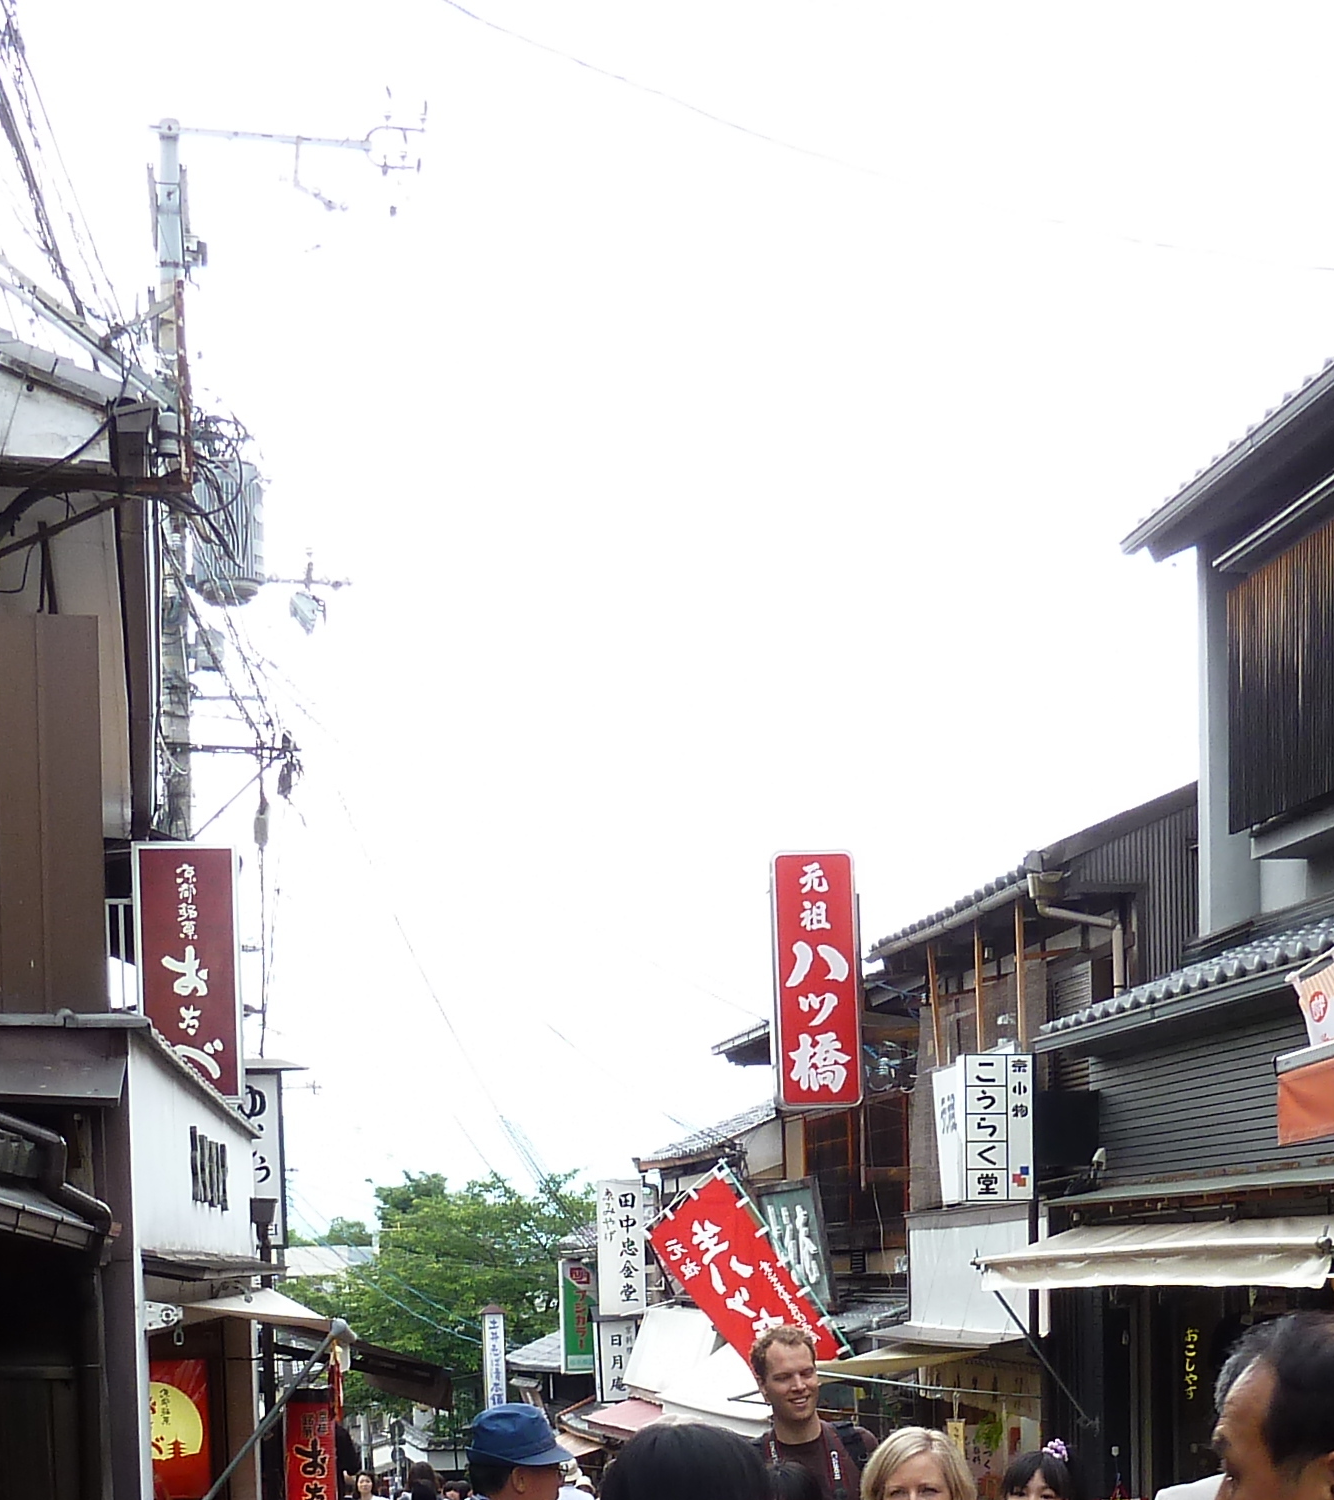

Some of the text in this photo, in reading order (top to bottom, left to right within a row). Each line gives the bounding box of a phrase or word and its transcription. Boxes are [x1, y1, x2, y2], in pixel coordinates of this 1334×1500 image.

[798, 861, 832, 932] 元祖
[1011, 1058, 1029, 1118] 京小物
[975, 1062, 998, 1196] こうらく堂
[1184, 1326, 1200, 1400] おこしやす
